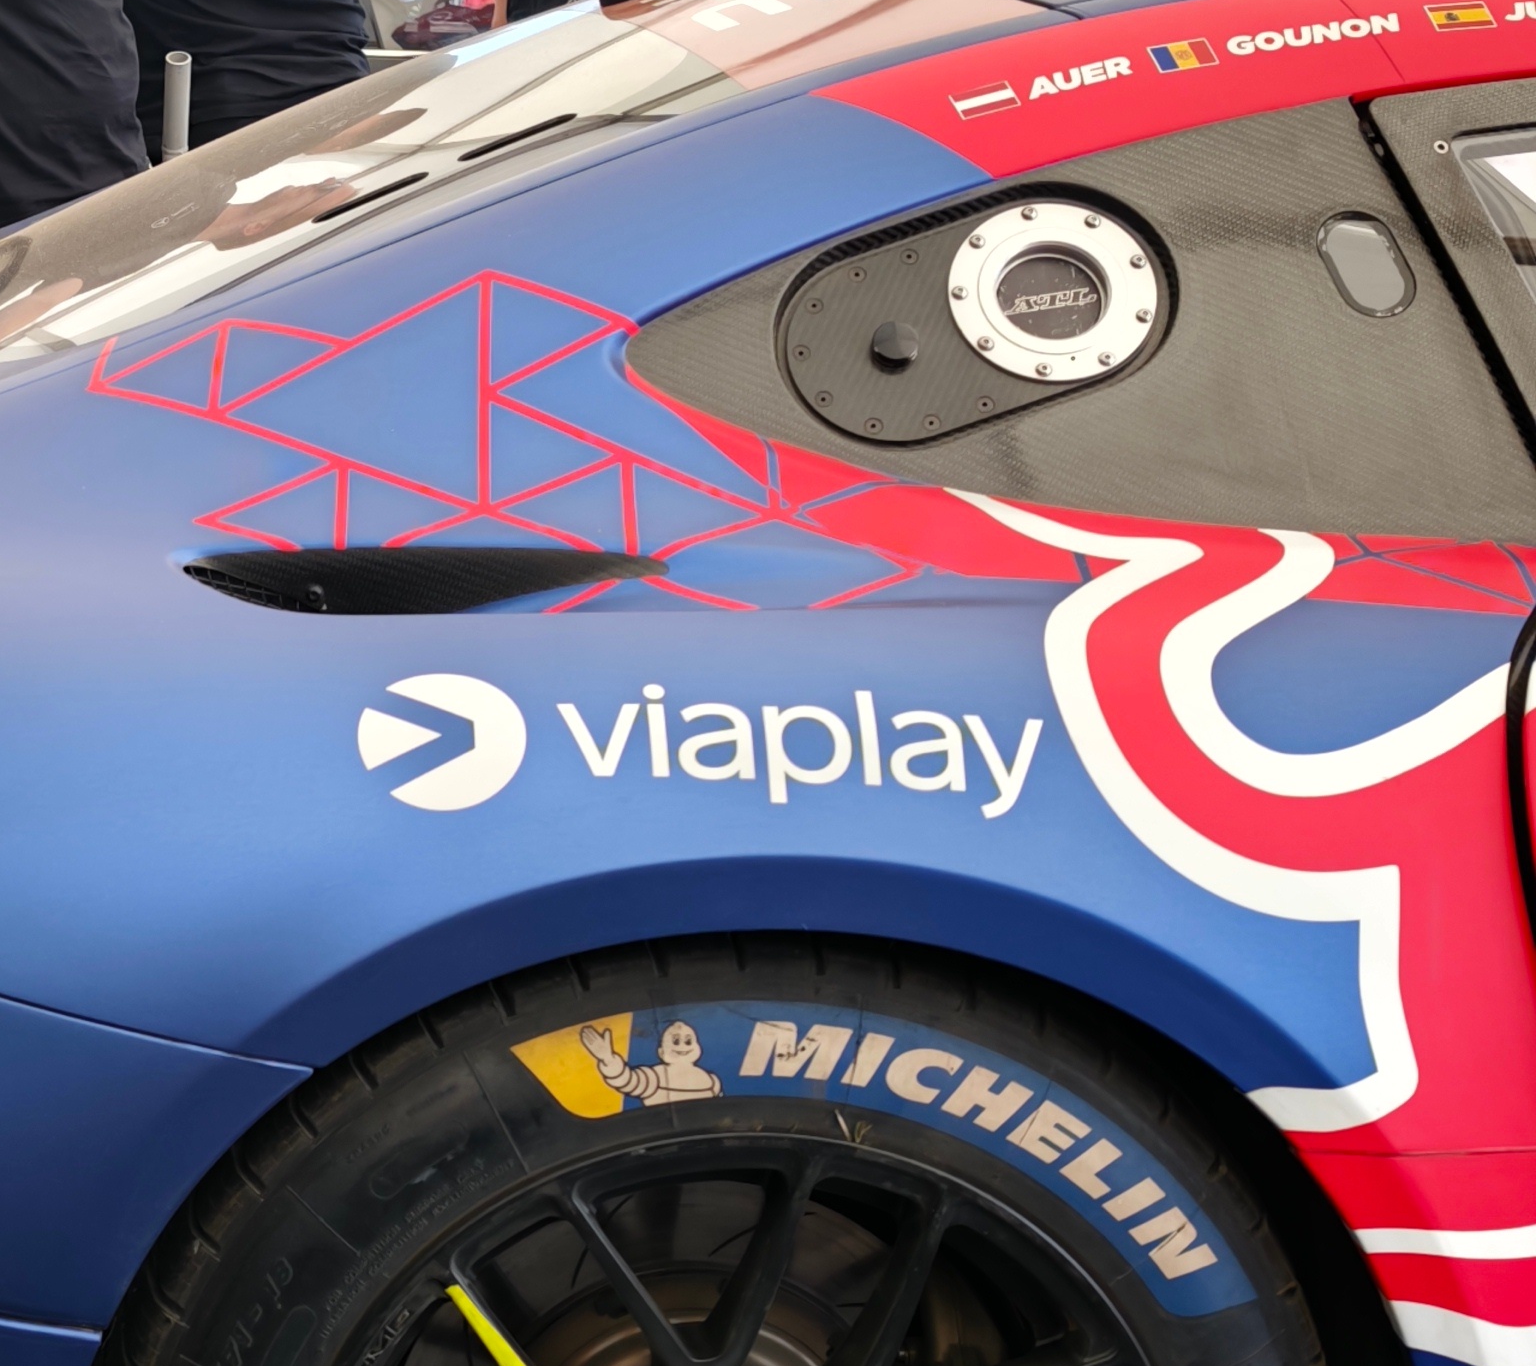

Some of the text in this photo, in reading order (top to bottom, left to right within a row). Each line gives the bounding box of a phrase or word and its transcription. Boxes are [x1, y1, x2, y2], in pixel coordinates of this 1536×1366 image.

[1028, 55, 1134, 101] AUER
[1226, 12, 1401, 56] GOUNON
[1005, 286, 1098, 316] ATL
[556, 683, 1045, 820] viaplay
[737, 1020, 1220, 1281] MICHELIN
